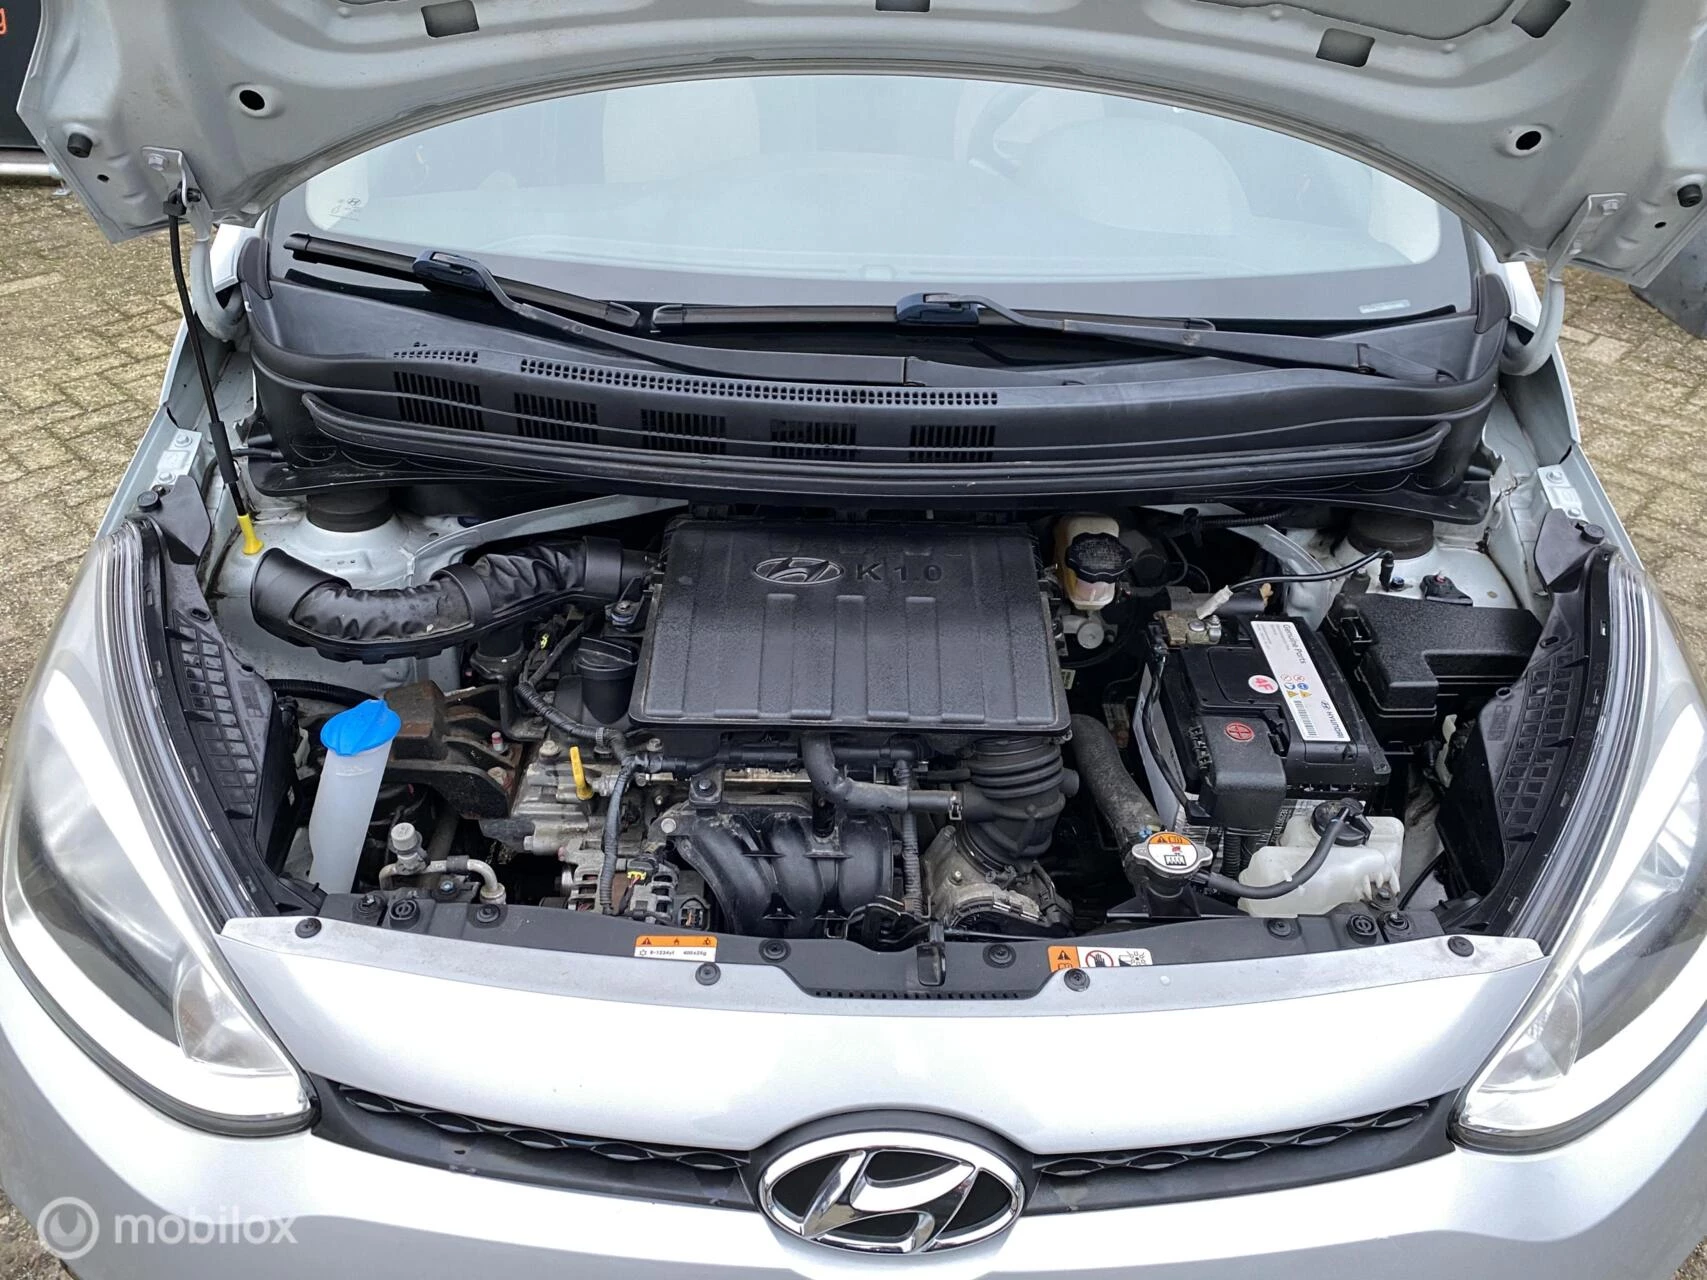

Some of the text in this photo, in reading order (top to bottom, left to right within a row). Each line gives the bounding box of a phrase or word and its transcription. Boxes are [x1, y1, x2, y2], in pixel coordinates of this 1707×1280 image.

[856, 562, 943, 582] K 1.0
[1283, 624, 1307, 664] Genuine Parts
[1327, 711, 1345, 738] HYUNDAI
